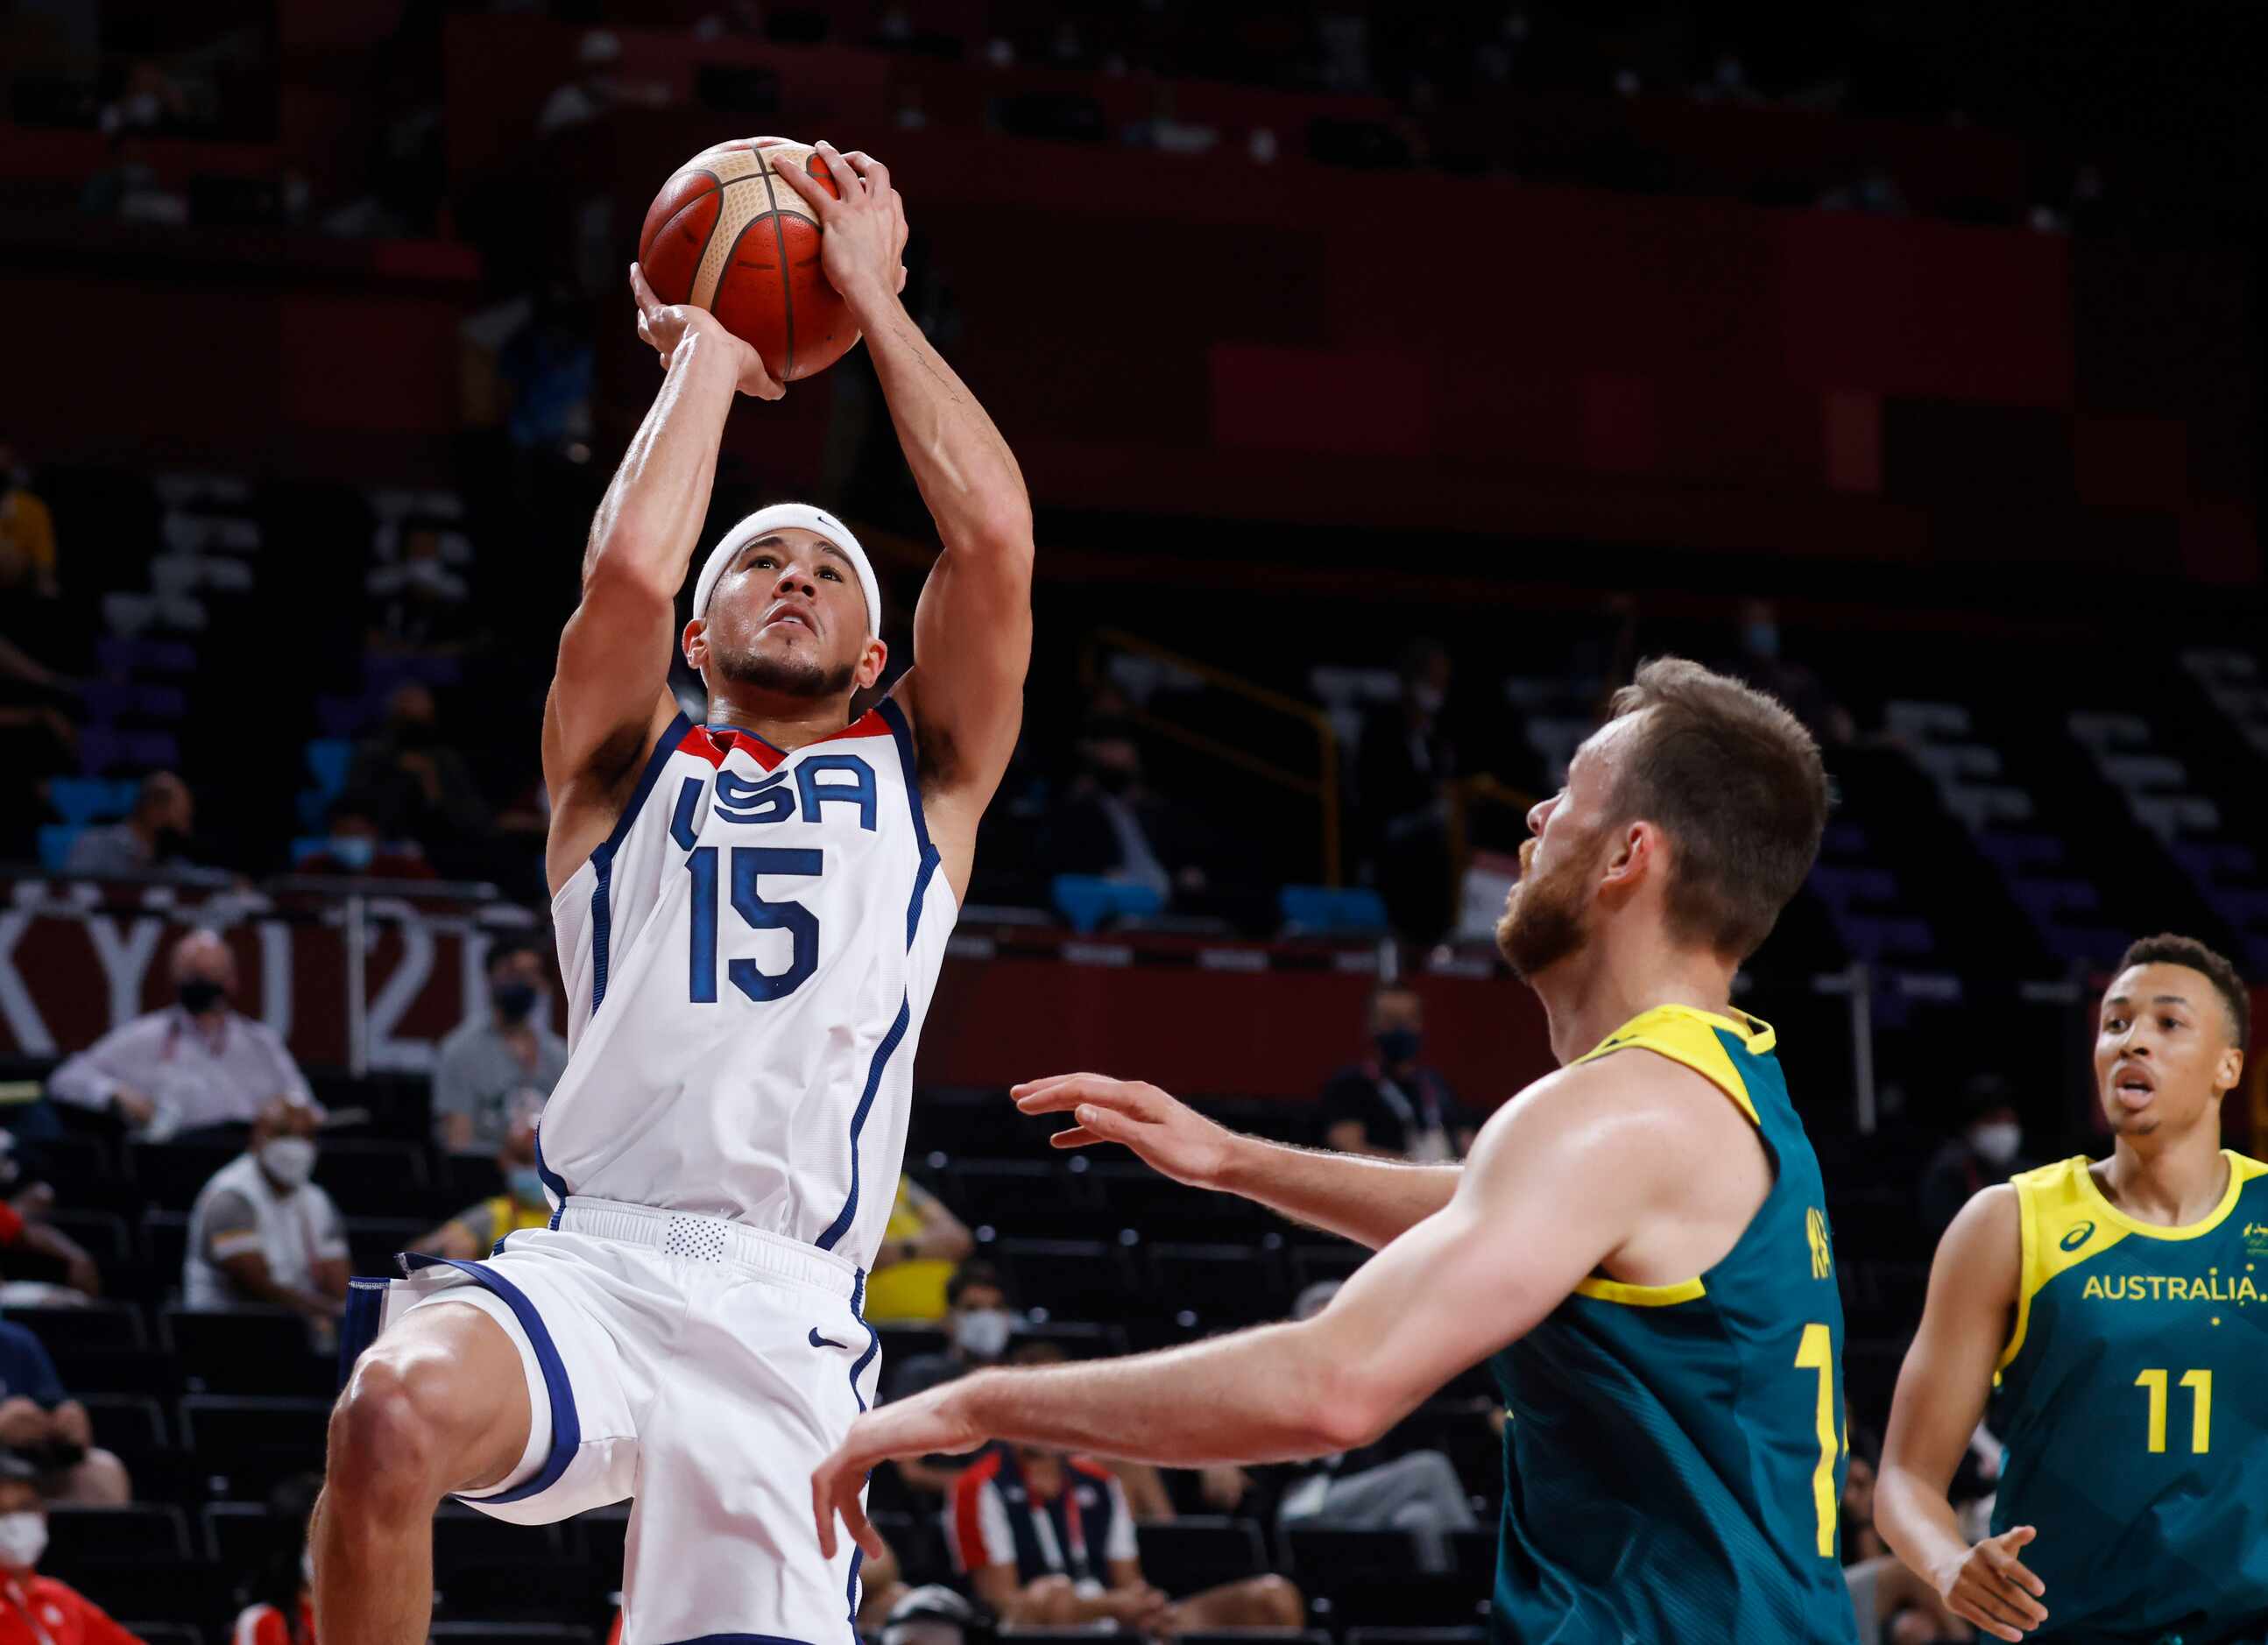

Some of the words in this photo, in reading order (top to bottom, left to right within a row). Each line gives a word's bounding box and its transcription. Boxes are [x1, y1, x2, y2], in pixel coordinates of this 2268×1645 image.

[684, 846, 823, 1004] 15
[2081, 1274, 2258, 1300] AUSTRALIA
[2134, 1368, 2212, 1454] 11
